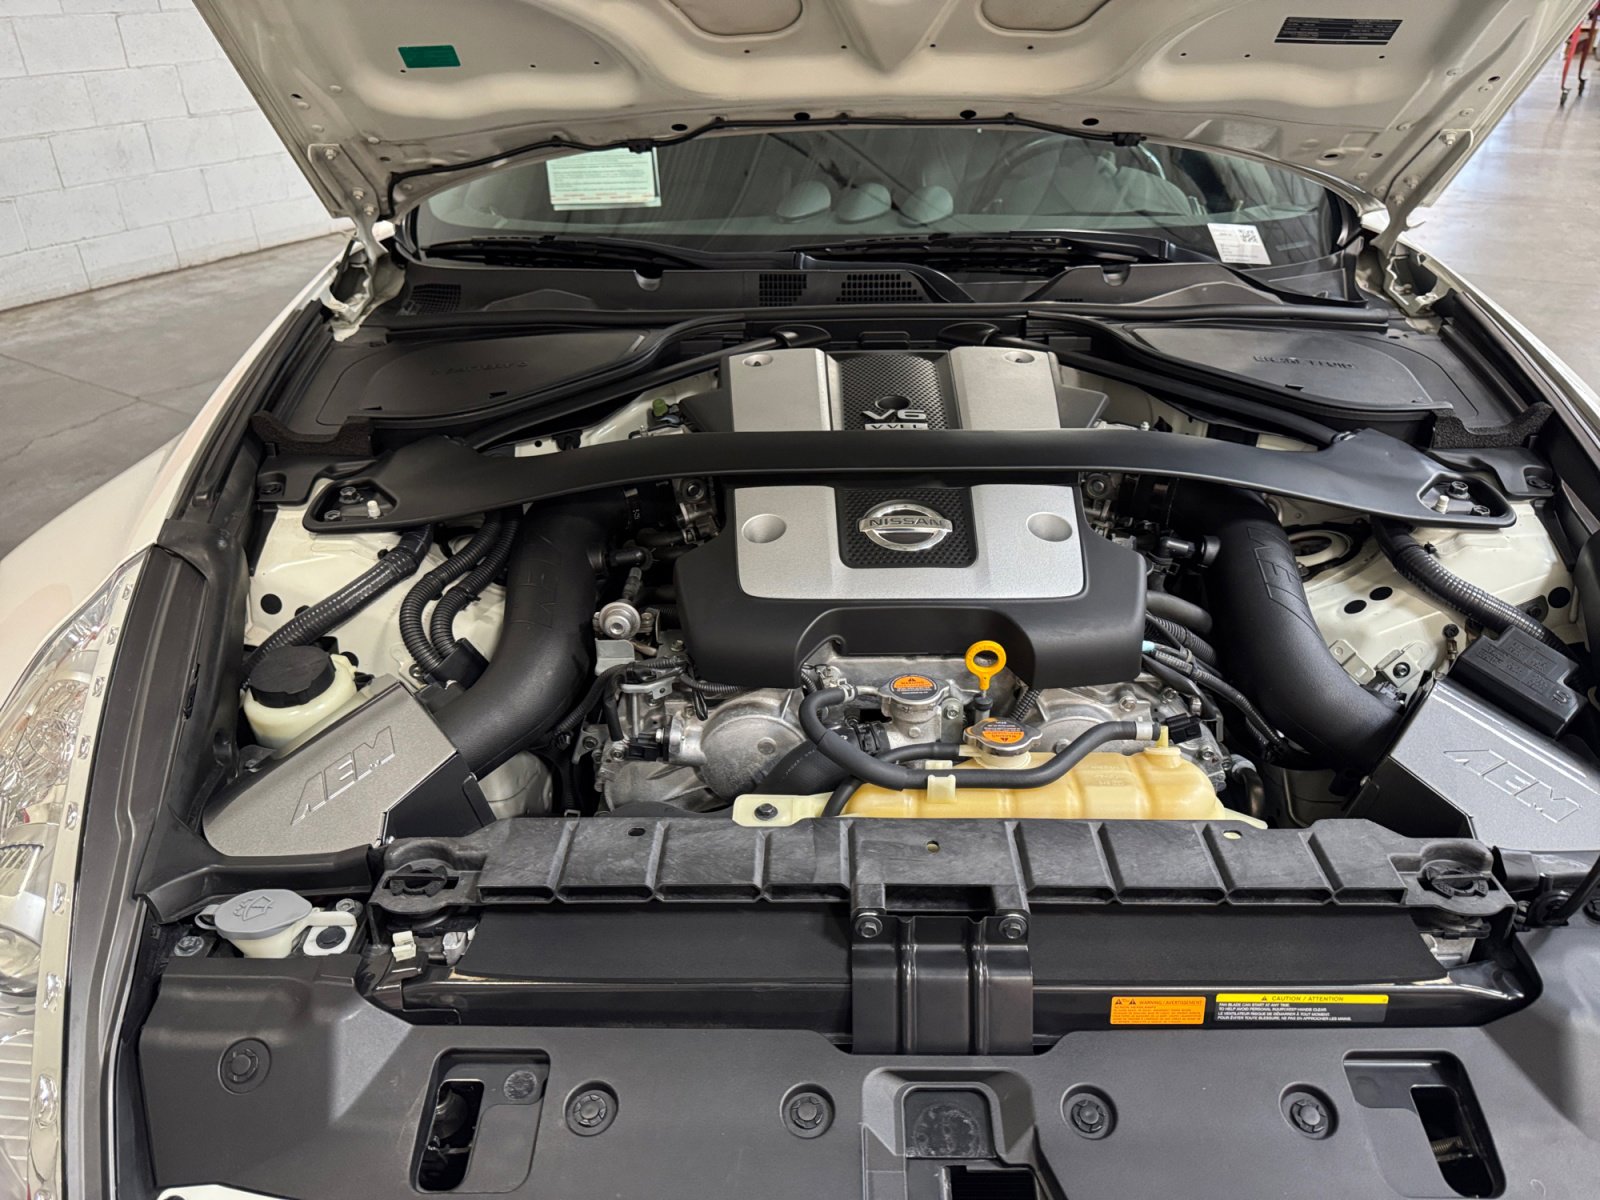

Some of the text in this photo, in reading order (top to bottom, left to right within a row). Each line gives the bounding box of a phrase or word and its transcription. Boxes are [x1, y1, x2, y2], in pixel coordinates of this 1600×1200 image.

[862, 409, 927, 420] V6
[869, 517, 943, 527] NISSAN
[290, 725, 396, 826] AEM
[1443, 749, 1582, 823] AEM
